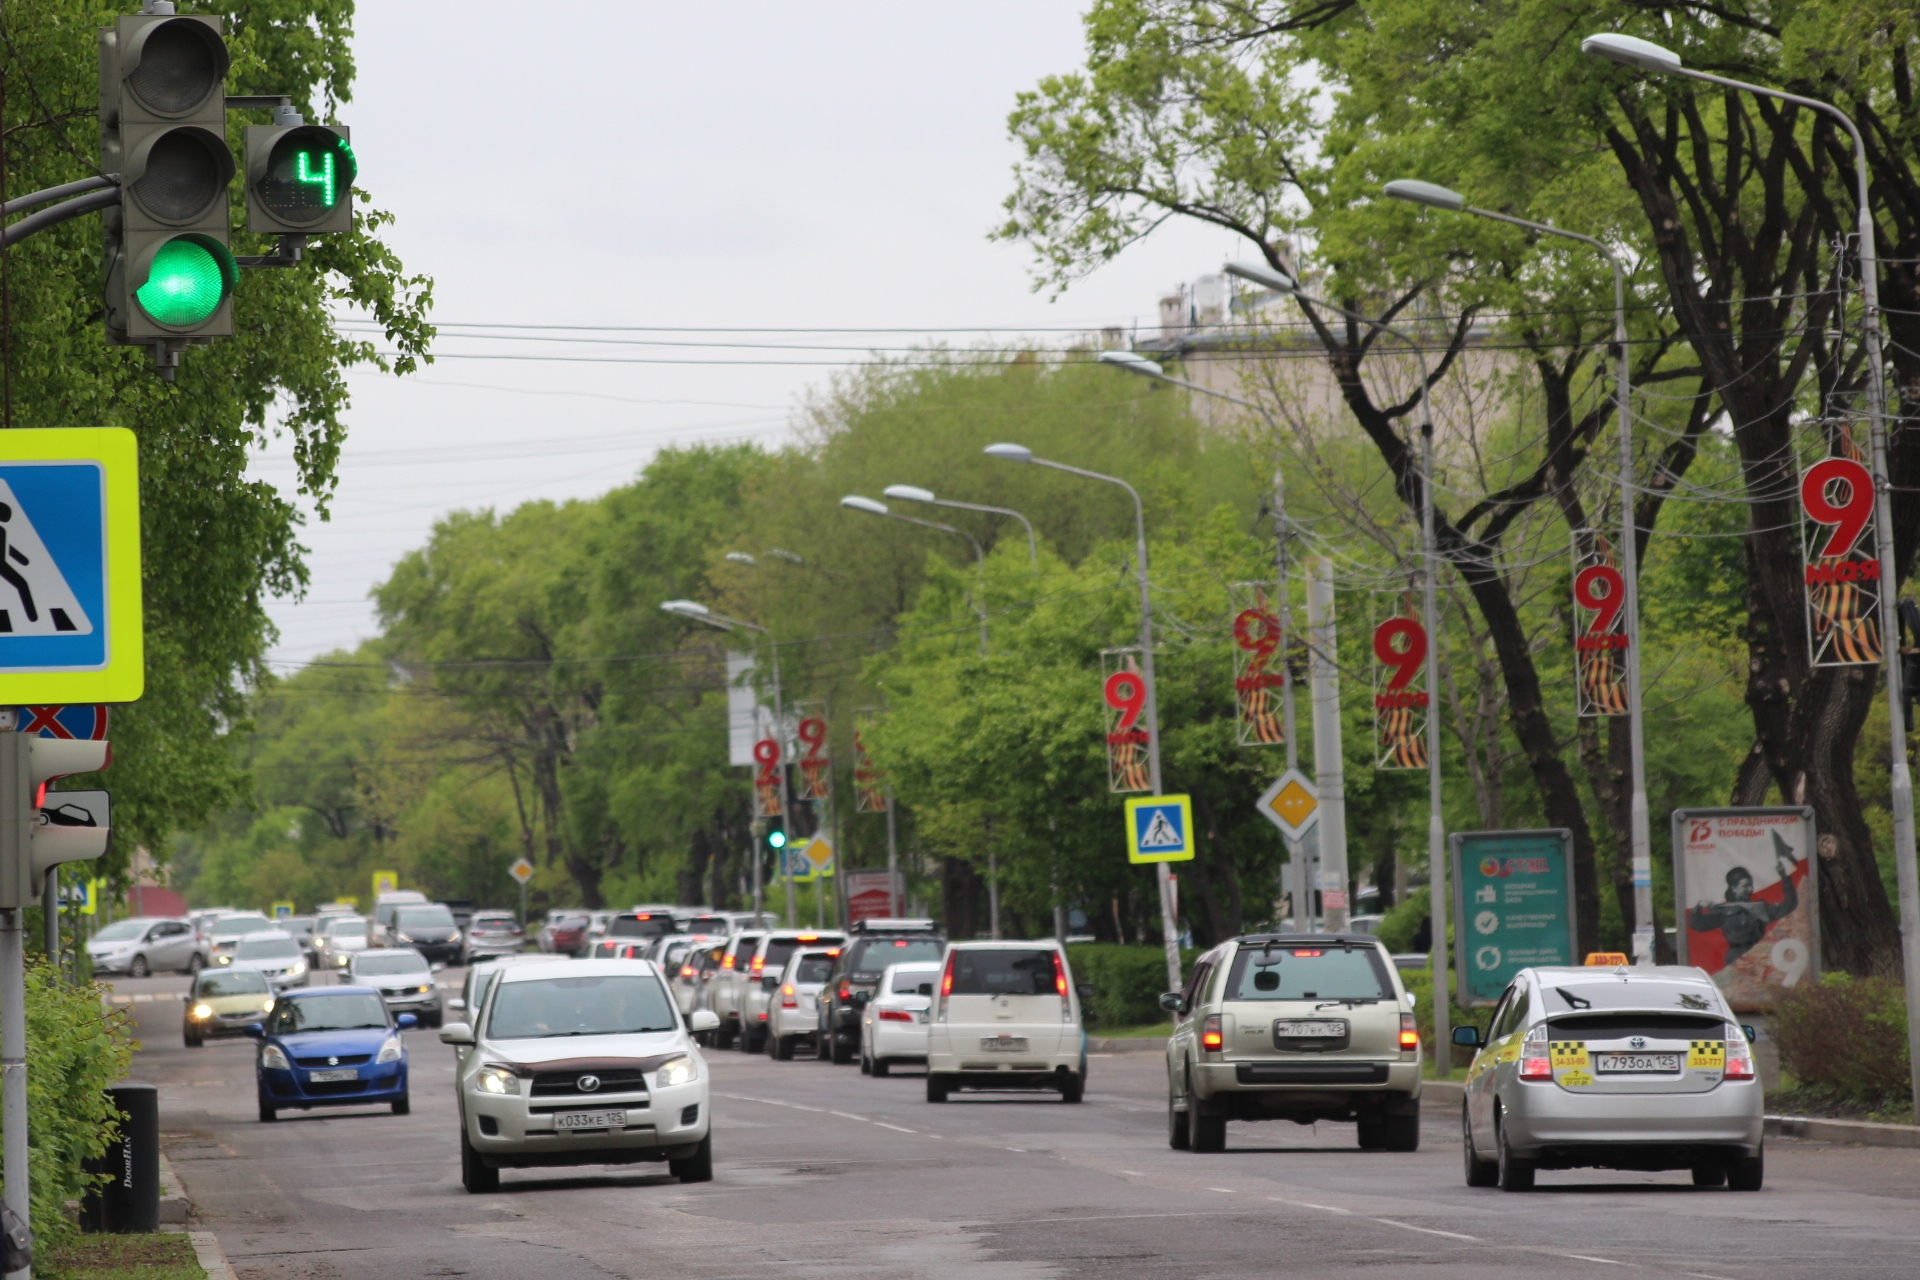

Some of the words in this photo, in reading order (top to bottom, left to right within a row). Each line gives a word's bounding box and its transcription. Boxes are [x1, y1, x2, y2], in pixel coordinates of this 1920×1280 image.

[298, 151, 334, 206] 4
[1801, 458, 1875, 558] 9
[1575, 565, 1625, 633] 9
[1233, 609, 1281, 672] 9
[1373, 617, 1427, 690] 9
[1104, 671, 1146, 728] 9
[753, 740, 780, 777] 9
[798, 717, 826, 759] 9
[1718, 819, 1724, 827] С
[1727, 816, 1798, 827] ПРАЗДНИКОМ
[1718, 829, 1765, 838] ПОБЕДЫ!
[1771, 938, 1809, 988] 9
[1602, 1056, 1654, 1069] К793ОА
[1655, 1055, 1675, 1066] 125
[1693, 1057, 1723, 1066] 333-777
[558, 1114, 603, 1127] К033КЕ
[605, 1111, 623, 1122] 125
